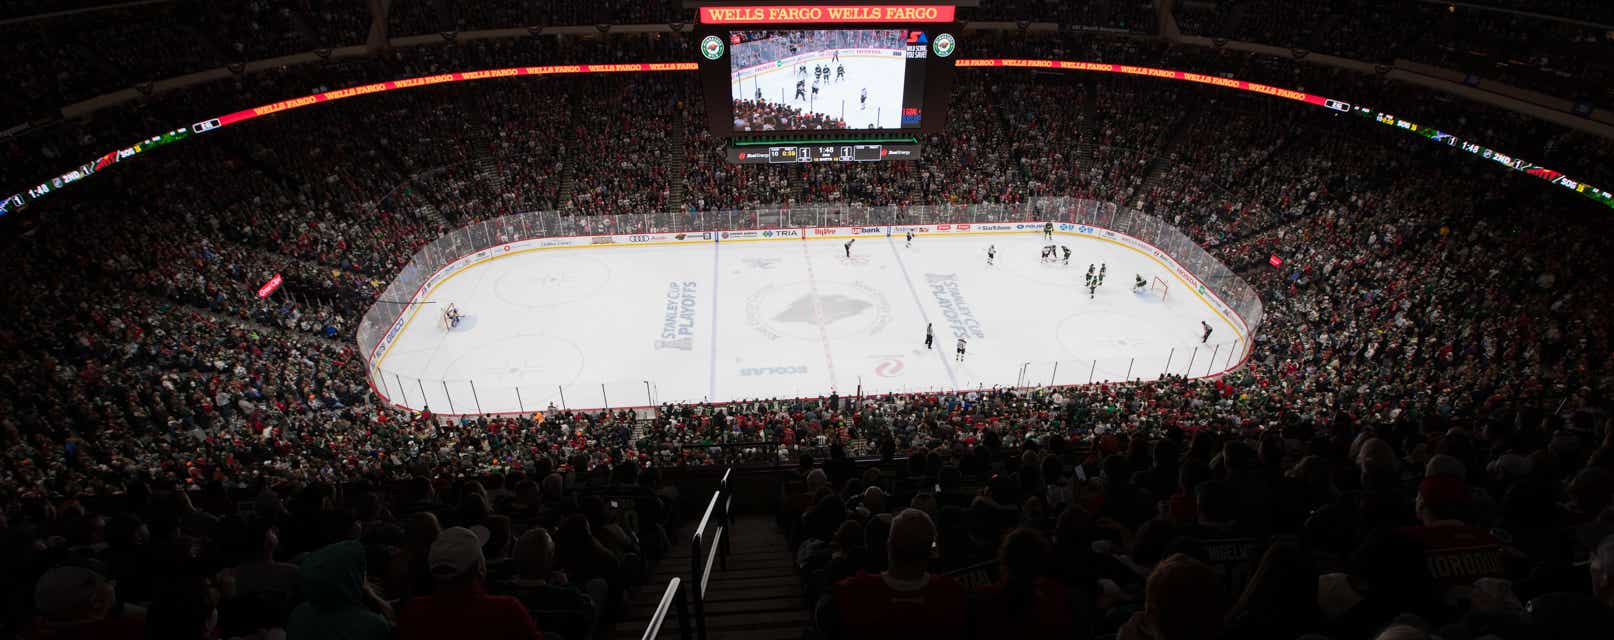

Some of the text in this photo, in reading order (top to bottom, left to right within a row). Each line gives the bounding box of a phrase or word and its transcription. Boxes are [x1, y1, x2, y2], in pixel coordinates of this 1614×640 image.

[708, 7, 938, 21] WELLS FARGO WELLS FARGO
[254, 103, 286, 116] WELLS
[287, 96, 317, 109] FARGO
[325, 88, 356, 100] WELLS
[357, 83, 387, 95] FARGO
[394, 78, 424, 88] WELLS
[425, 74, 454, 85] FARGO
[462, 71, 490, 80] WELLS
[491, 68, 519, 78] FARGO
[527, 67, 554, 75] WELLS
[555, 65, 581, 73] FARGO
[589, 64, 615, 72] WELLS
[649, 63, 676, 71] WELLS
[970, 59, 994, 67] FARGO
[1002, 59, 1027, 67] WELLS
[1028, 60, 1053, 68] FARGO
[1060, 62, 1086, 70] WELLS
[1087, 63, 1113, 72] FARGO
[1120, 66, 1147, 76] WELLS
[1148, 68, 1176, 78] FARGO
[1184, 73, 1211, 84] WELLS
[1212, 77, 1240, 88] FARGO
[1248, 83, 1276, 96] WELLS
[1277, 89, 1306, 101] FARGO
[1462, 141, 1480, 153] 1:48
[1493, 153, 1511, 164] 2ND
[28, 183, 50, 198] 1:48
[661, 281, 681, 339] STANLEY CUP
[678, 281, 697, 336] PLAYOFFS
[929, 284, 971, 339] PLAYOFFS
[386, 317, 405, 343] GEICO
